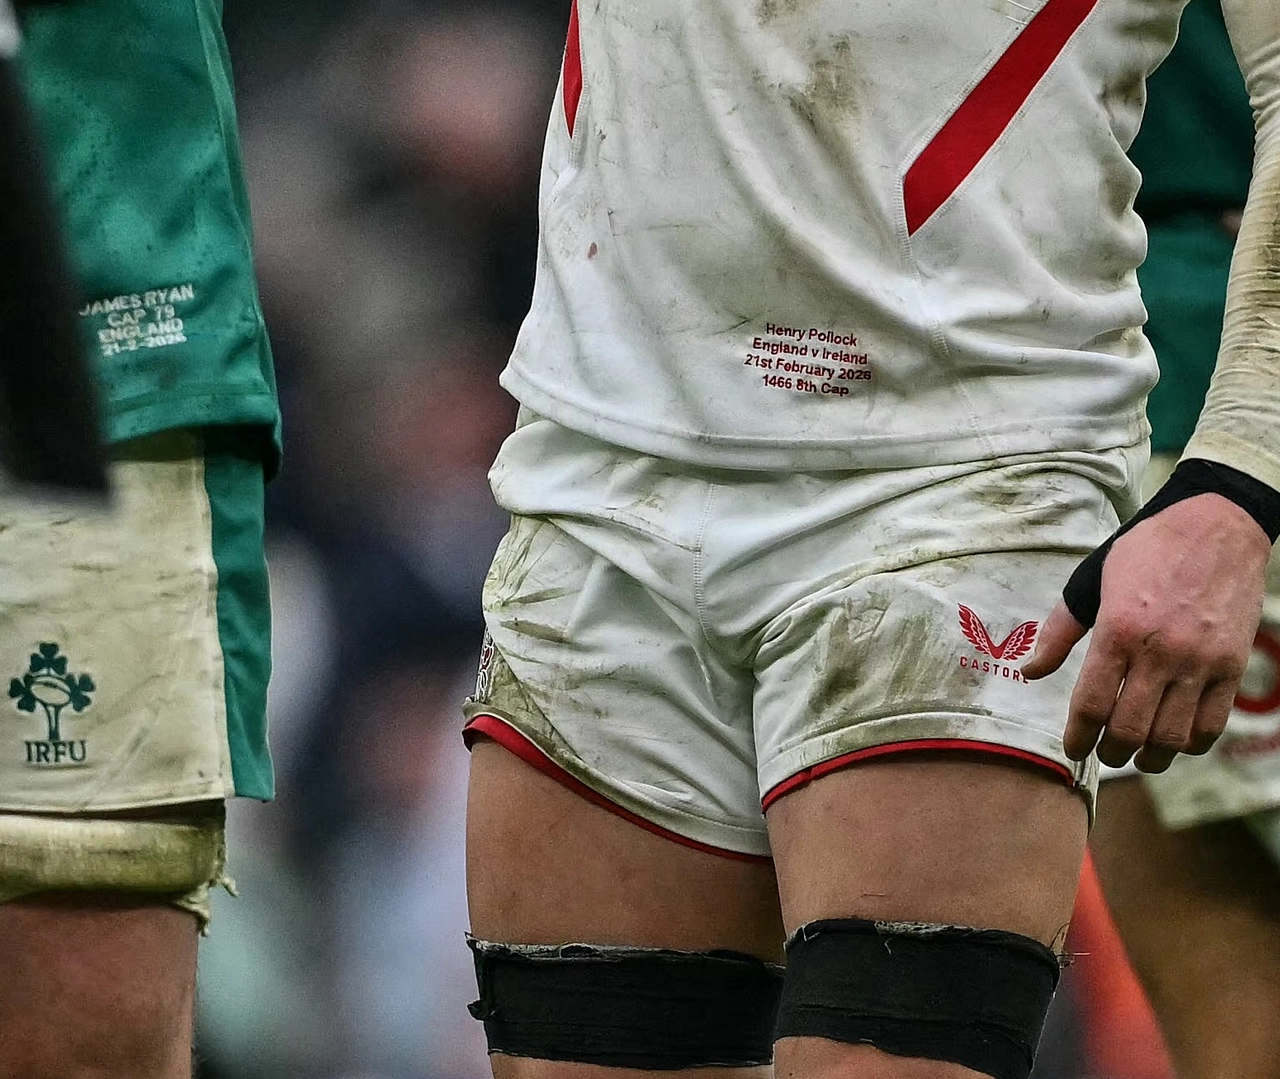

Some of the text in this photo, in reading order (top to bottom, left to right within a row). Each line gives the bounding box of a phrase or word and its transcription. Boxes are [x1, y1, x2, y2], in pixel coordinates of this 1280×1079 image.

[79, 282, 195, 317] JAMES RYAN
[107, 308, 147, 327] CAP
[97, 317, 184, 344] ENGLAND
[766, 323, 858, 347] Henry Pollock
[752, 337, 868, 365] England v Ireland
[744, 354, 872, 381] 21st February 2026
[762, 374, 849, 397] 1466 8th Cap
[24, 740, 87, 762] IRFU
